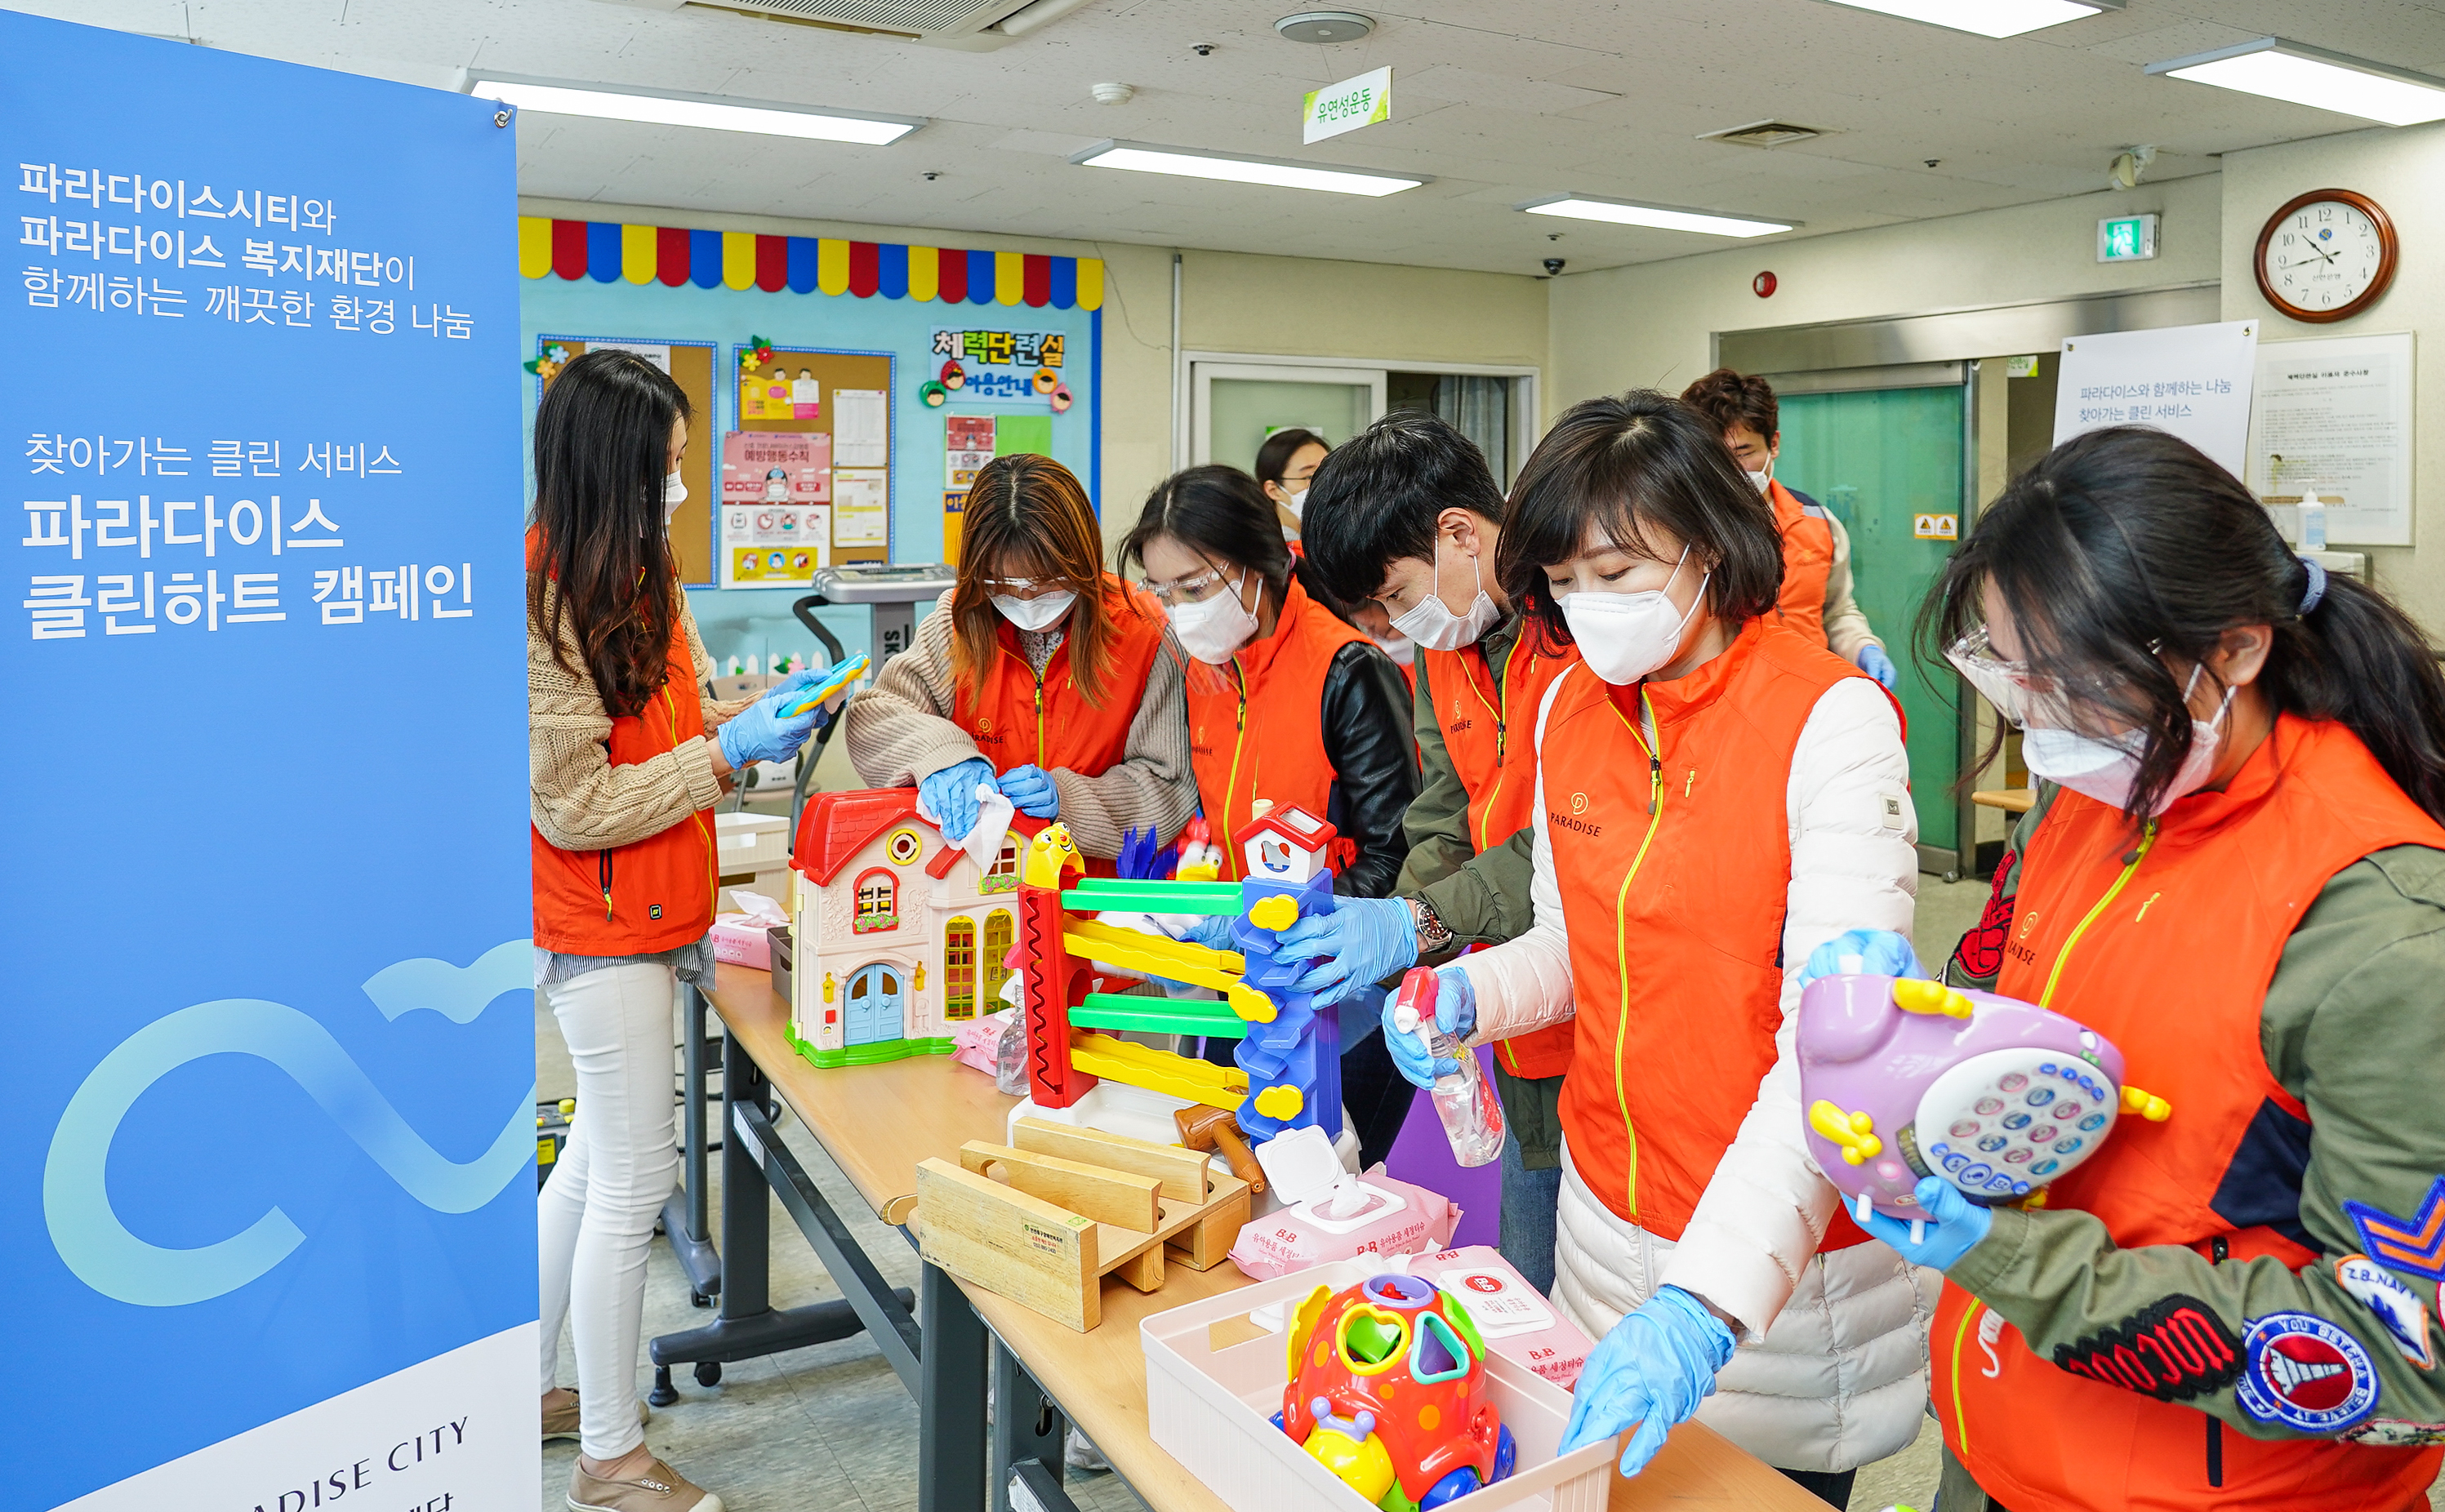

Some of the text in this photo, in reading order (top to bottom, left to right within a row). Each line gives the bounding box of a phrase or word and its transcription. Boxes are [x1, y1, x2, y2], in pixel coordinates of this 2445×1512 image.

[1317, 87, 1372, 124] 유연성운동
[19, 162, 337, 236] 파라다이스시티와
[2298, 216, 2308, 229] 11
[2318, 207, 2331, 221] 12
[2282, 233, 2295, 247] 10
[2358, 224, 2367, 238] 2
[20, 215, 415, 291] 파라다이스 복지재단이
[2366, 245, 2374, 258] 3
[2278, 255, 2287, 269] 9
[2283, 274, 2292, 286] 8
[2358, 266, 2367, 279] 4
[2301, 289, 2309, 301] 7
[2322, 291, 2331, 305] 6
[2344, 284, 2352, 298] 5
[21, 265, 474, 340] 함께하는 깨끗한 환경 나눔
[932, 330, 1065, 368] 체력단련실
[965, 371, 1033, 398] 이용안내
[2080, 378, 2232, 401] 파라다이스와 함께하는 나눔
[2079, 403, 2192, 423] 찾아가는 클린 서비스
[24, 433, 403, 479] 찾아가는 클린 서비스
[744, 450, 810, 463] 예방행동수칙
[22, 494, 344, 559] 파라다이스
[22, 563, 474, 640] 클린하트 캠페인
[884, 629, 900, 662] SK
[971, 732, 1004, 745] RADISE
[1550, 812, 1602, 837] PARADISE
[1252, 1233, 1278, 1252] 유아용품
[1279, 1246, 1301, 1259] 세정티
[1356, 1241, 1378, 1256] BB
[1379, 1234, 1403, 1248] 유아용품
[2278, 1319, 2368, 1380] YOU BETCHA
[1530, 1357, 1584, 1375] 용품 세정티슈
[2319, 1387, 2368, 1422] BELIEVE
[388, 1416, 468, 1471] CITY
